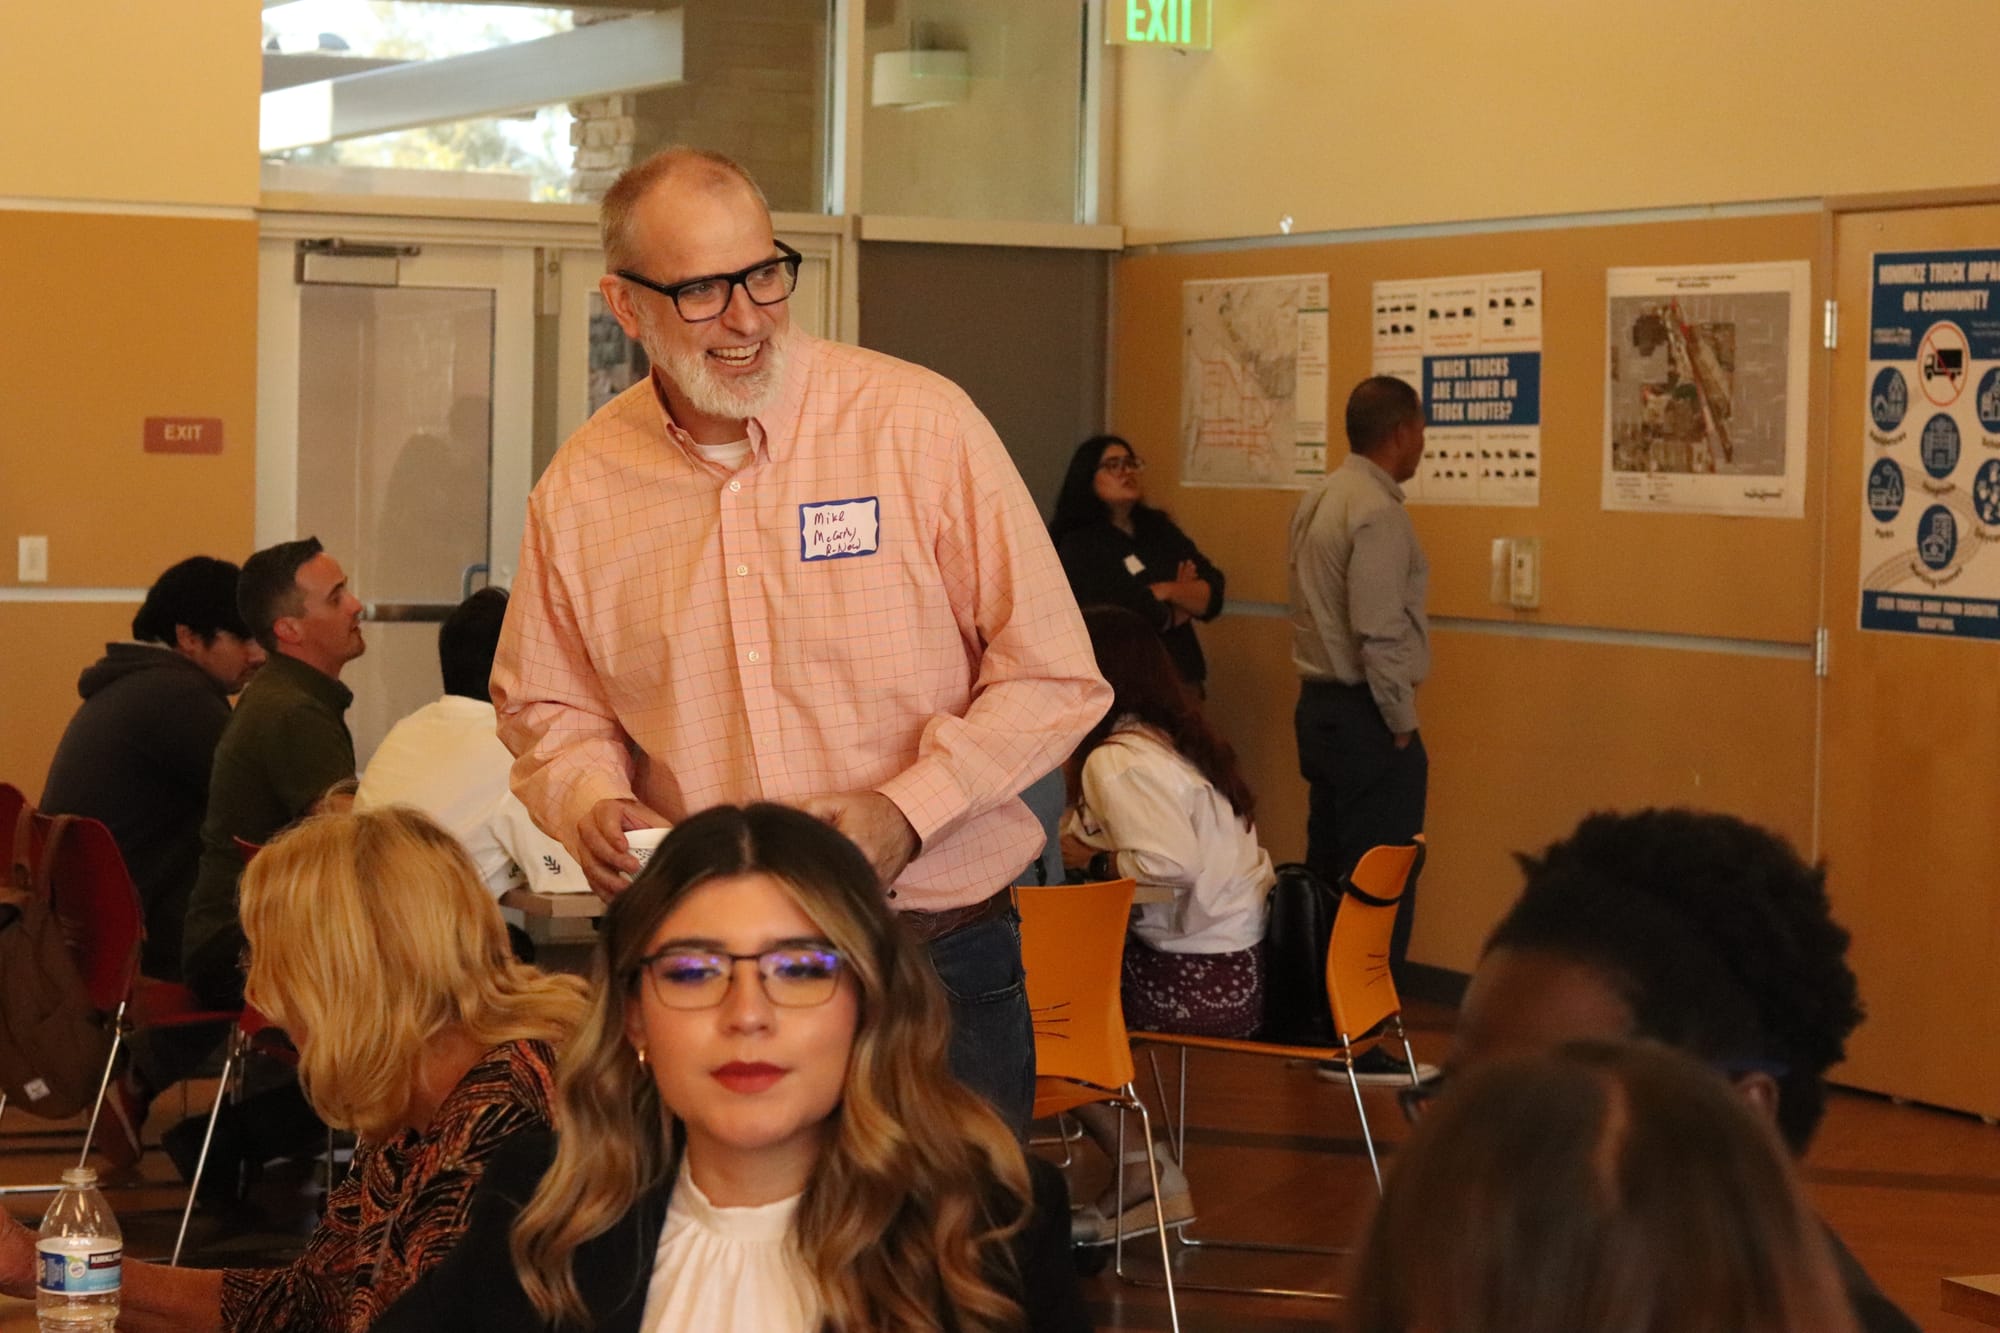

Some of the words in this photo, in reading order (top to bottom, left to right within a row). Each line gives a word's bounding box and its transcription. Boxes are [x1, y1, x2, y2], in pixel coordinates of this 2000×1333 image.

[1432, 359, 1466, 378] WHICH
[1469, 357, 1509, 377] TRUCKS
[1432, 381, 1451, 400] ARE
[1454, 380, 1500, 399] ALLOWED
[1503, 379, 1517, 398] ON
[1432, 402, 1464, 421] TRUCK
[1467, 400, 1512, 420] ROUTES?
[164, 424, 203, 441] EXIT
[814, 510, 845, 526] Mike
